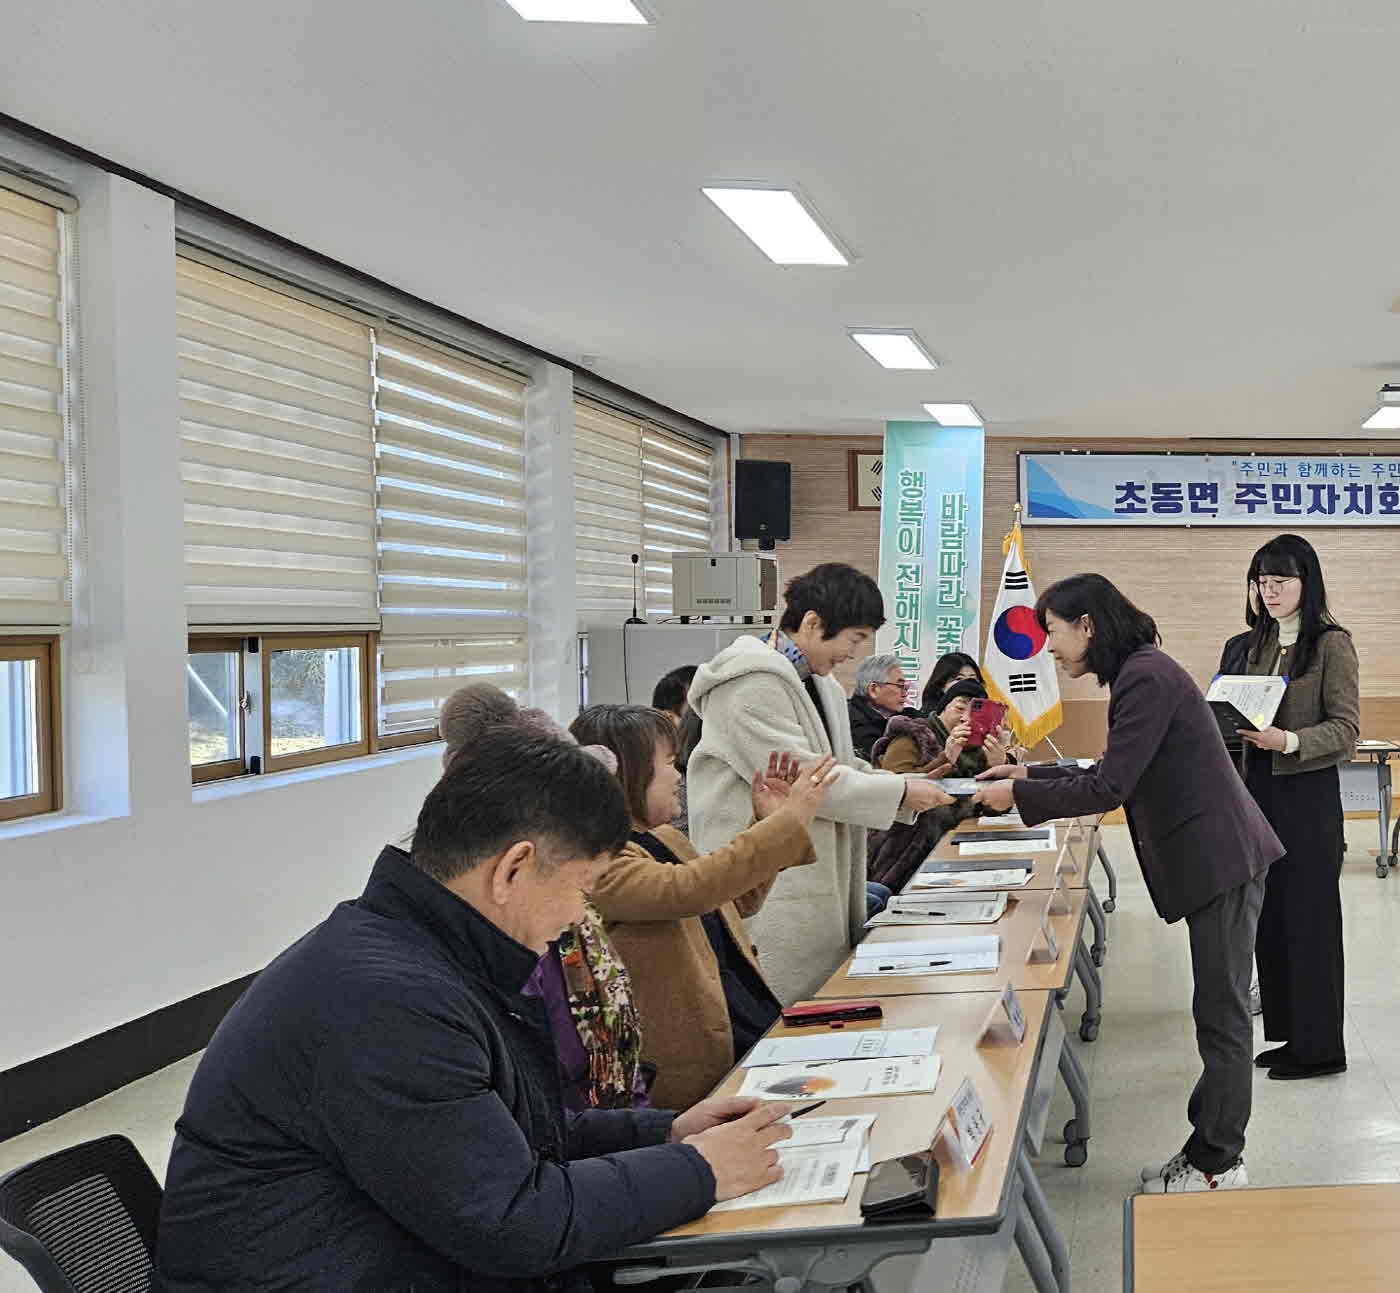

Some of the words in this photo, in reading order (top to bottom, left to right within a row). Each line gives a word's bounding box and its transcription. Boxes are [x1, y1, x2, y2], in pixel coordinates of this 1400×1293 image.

[898, 470, 924, 556] 행복이
[1114, 482, 1219, 514] 초동면
[1232, 462, 1287, 478] "주민과
[1298, 463, 1361, 478] 함께하는
[936, 493, 968, 607] 바람따라
[894, 564, 920, 681] 전해지는
